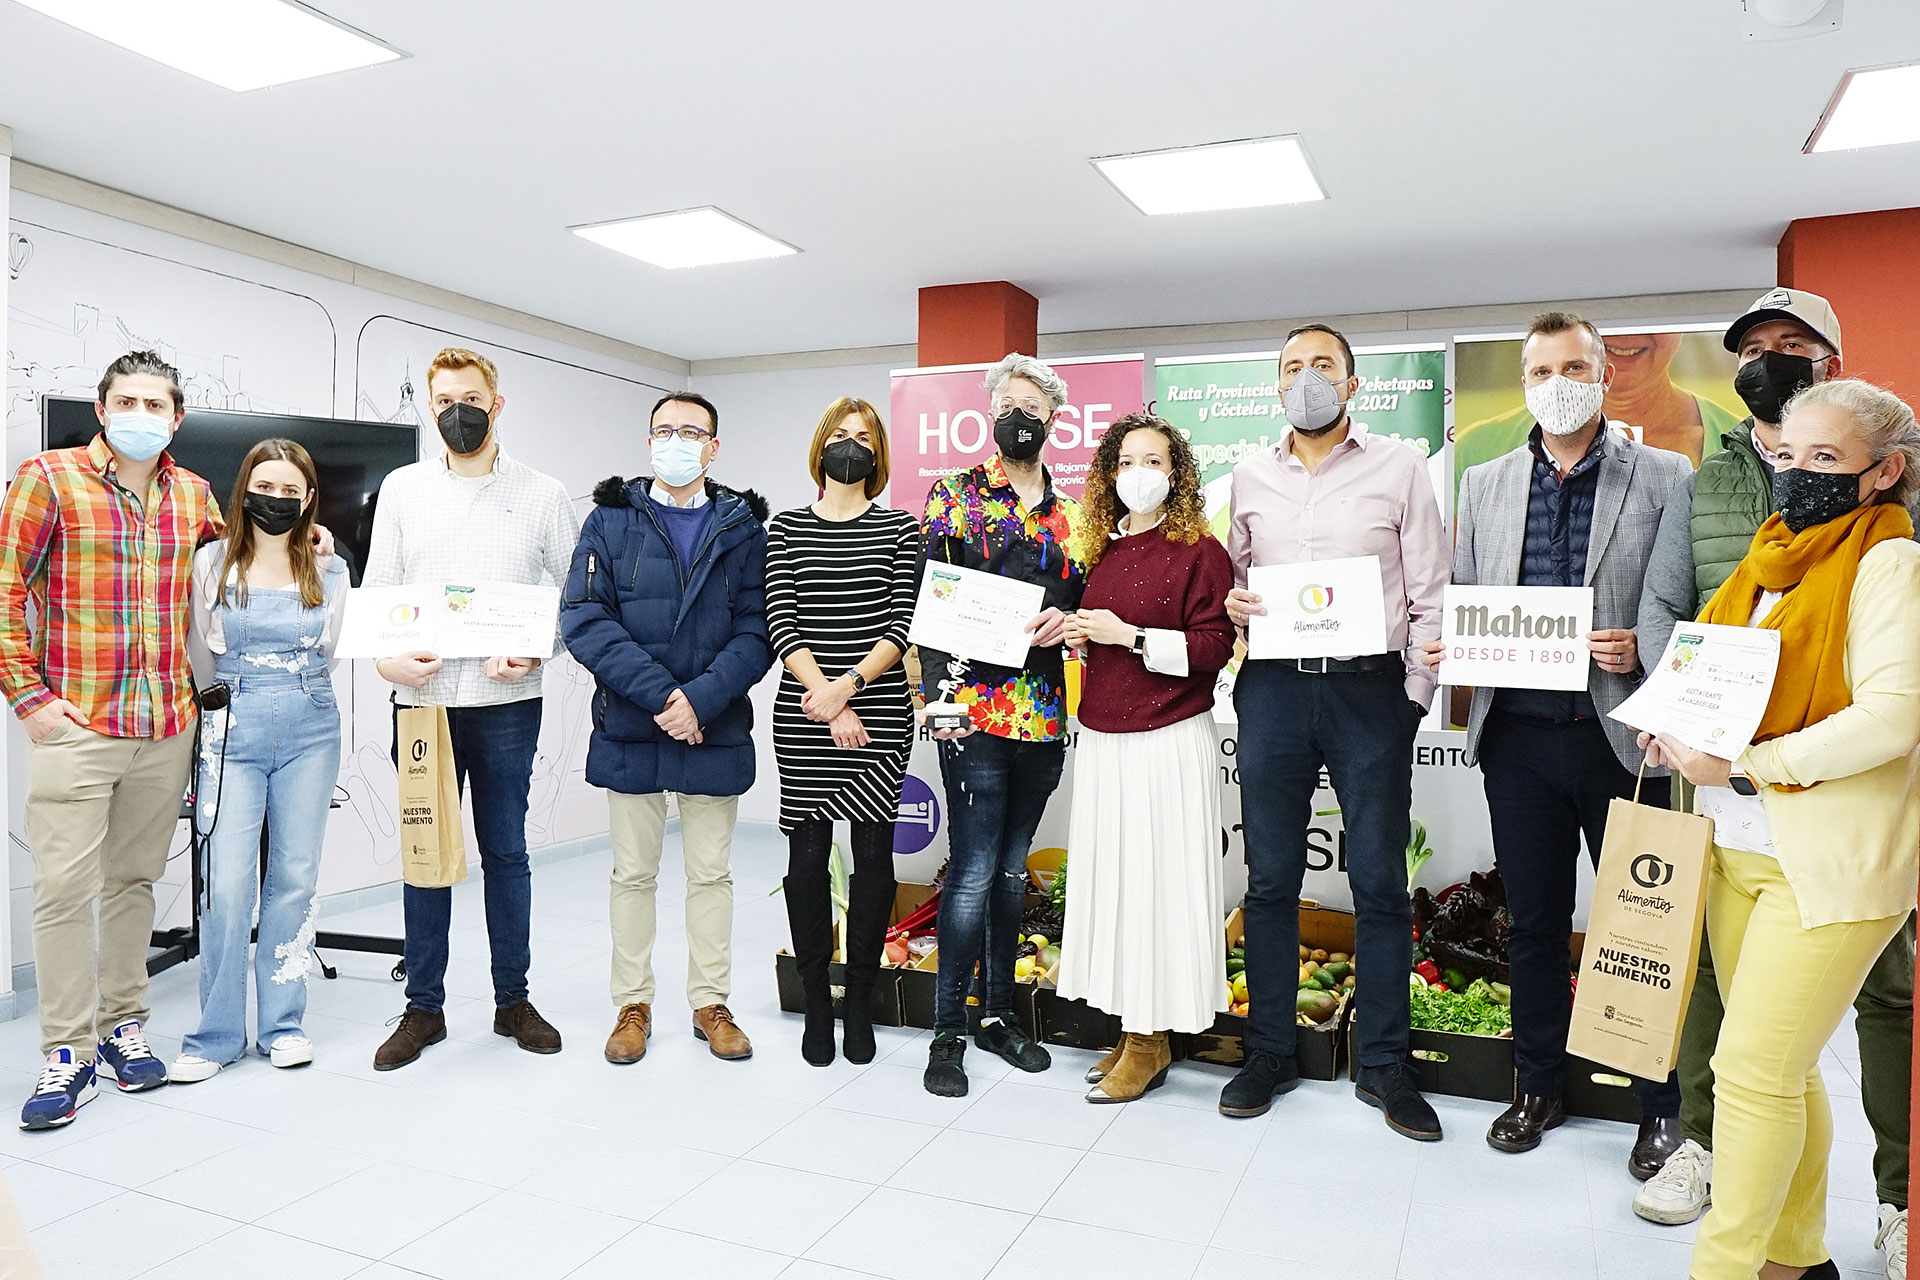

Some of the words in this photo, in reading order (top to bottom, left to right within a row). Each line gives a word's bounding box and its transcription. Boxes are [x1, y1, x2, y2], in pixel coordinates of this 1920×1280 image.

[1167, 385, 1202, 401] Ruta
[1205, 380, 1279, 400] Provincial
[1356, 375, 1434, 395] Peketapas
[1198, 407, 1208, 422] y
[1211, 400, 1268, 418] Cócteles
[1357, 393, 1399, 411] 2021
[918, 403, 1112, 455] HOSE
[1293, 618, 1342, 633] Alimentos
[1454, 604, 1579, 640] Mahou
[1453, 646, 1517, 662] DESDE
[1529, 649, 1575, 664] 1890
[402, 807, 432, 816] NUESTRO
[402, 816, 433, 825] ALIMENTO
[1617, 888, 1675, 914] Alimentos
[1634, 908, 1663, 919] SEGOVIA
[1598, 946, 1671, 975] NUESTRO
[1592, 959, 1672, 990] ALIMENTO
